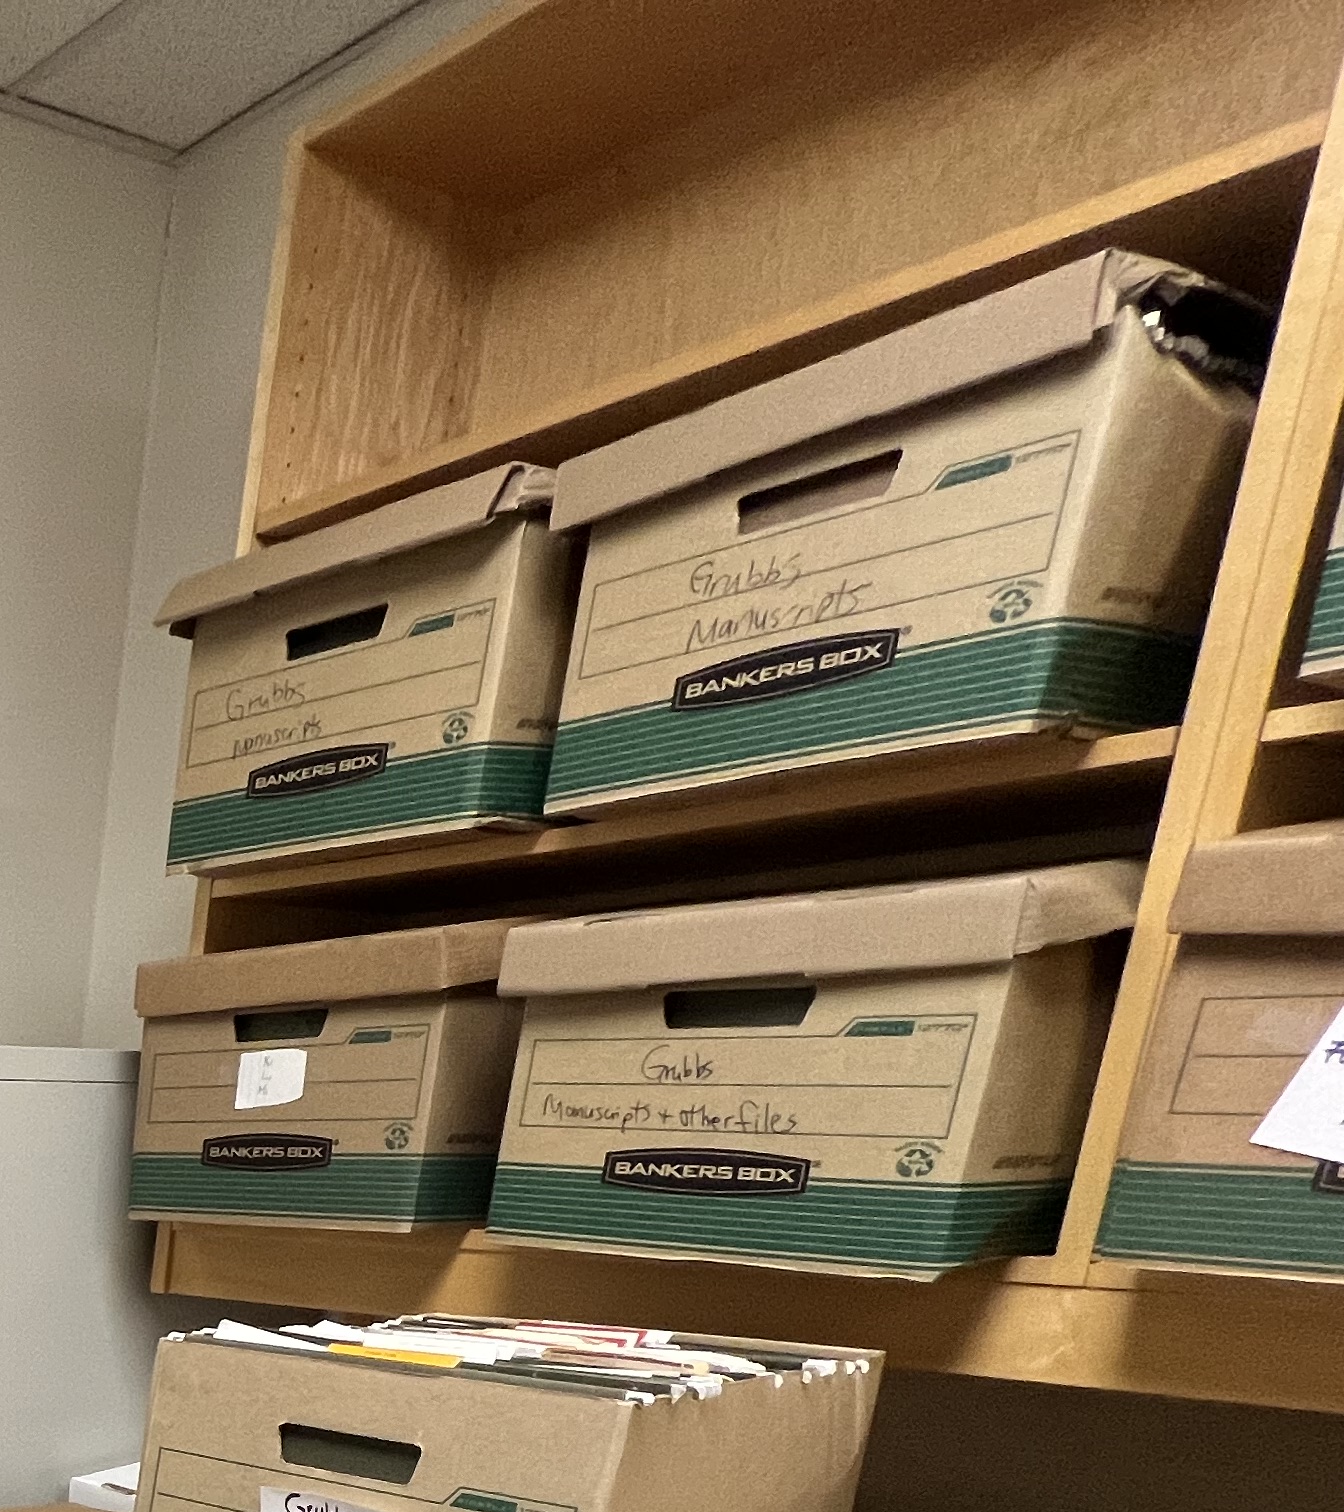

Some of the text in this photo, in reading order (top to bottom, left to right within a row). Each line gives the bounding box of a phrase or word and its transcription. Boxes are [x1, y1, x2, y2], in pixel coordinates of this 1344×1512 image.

[685, 641, 883, 699] BANKERS BOX
[254, 751, 379, 790] BANKERS BOX
[641, 1044, 714, 1083] Grubbs
[209, 1146, 323, 1159] BANKERS BOX
[615, 1161, 796, 1183] BANKERS BOX
